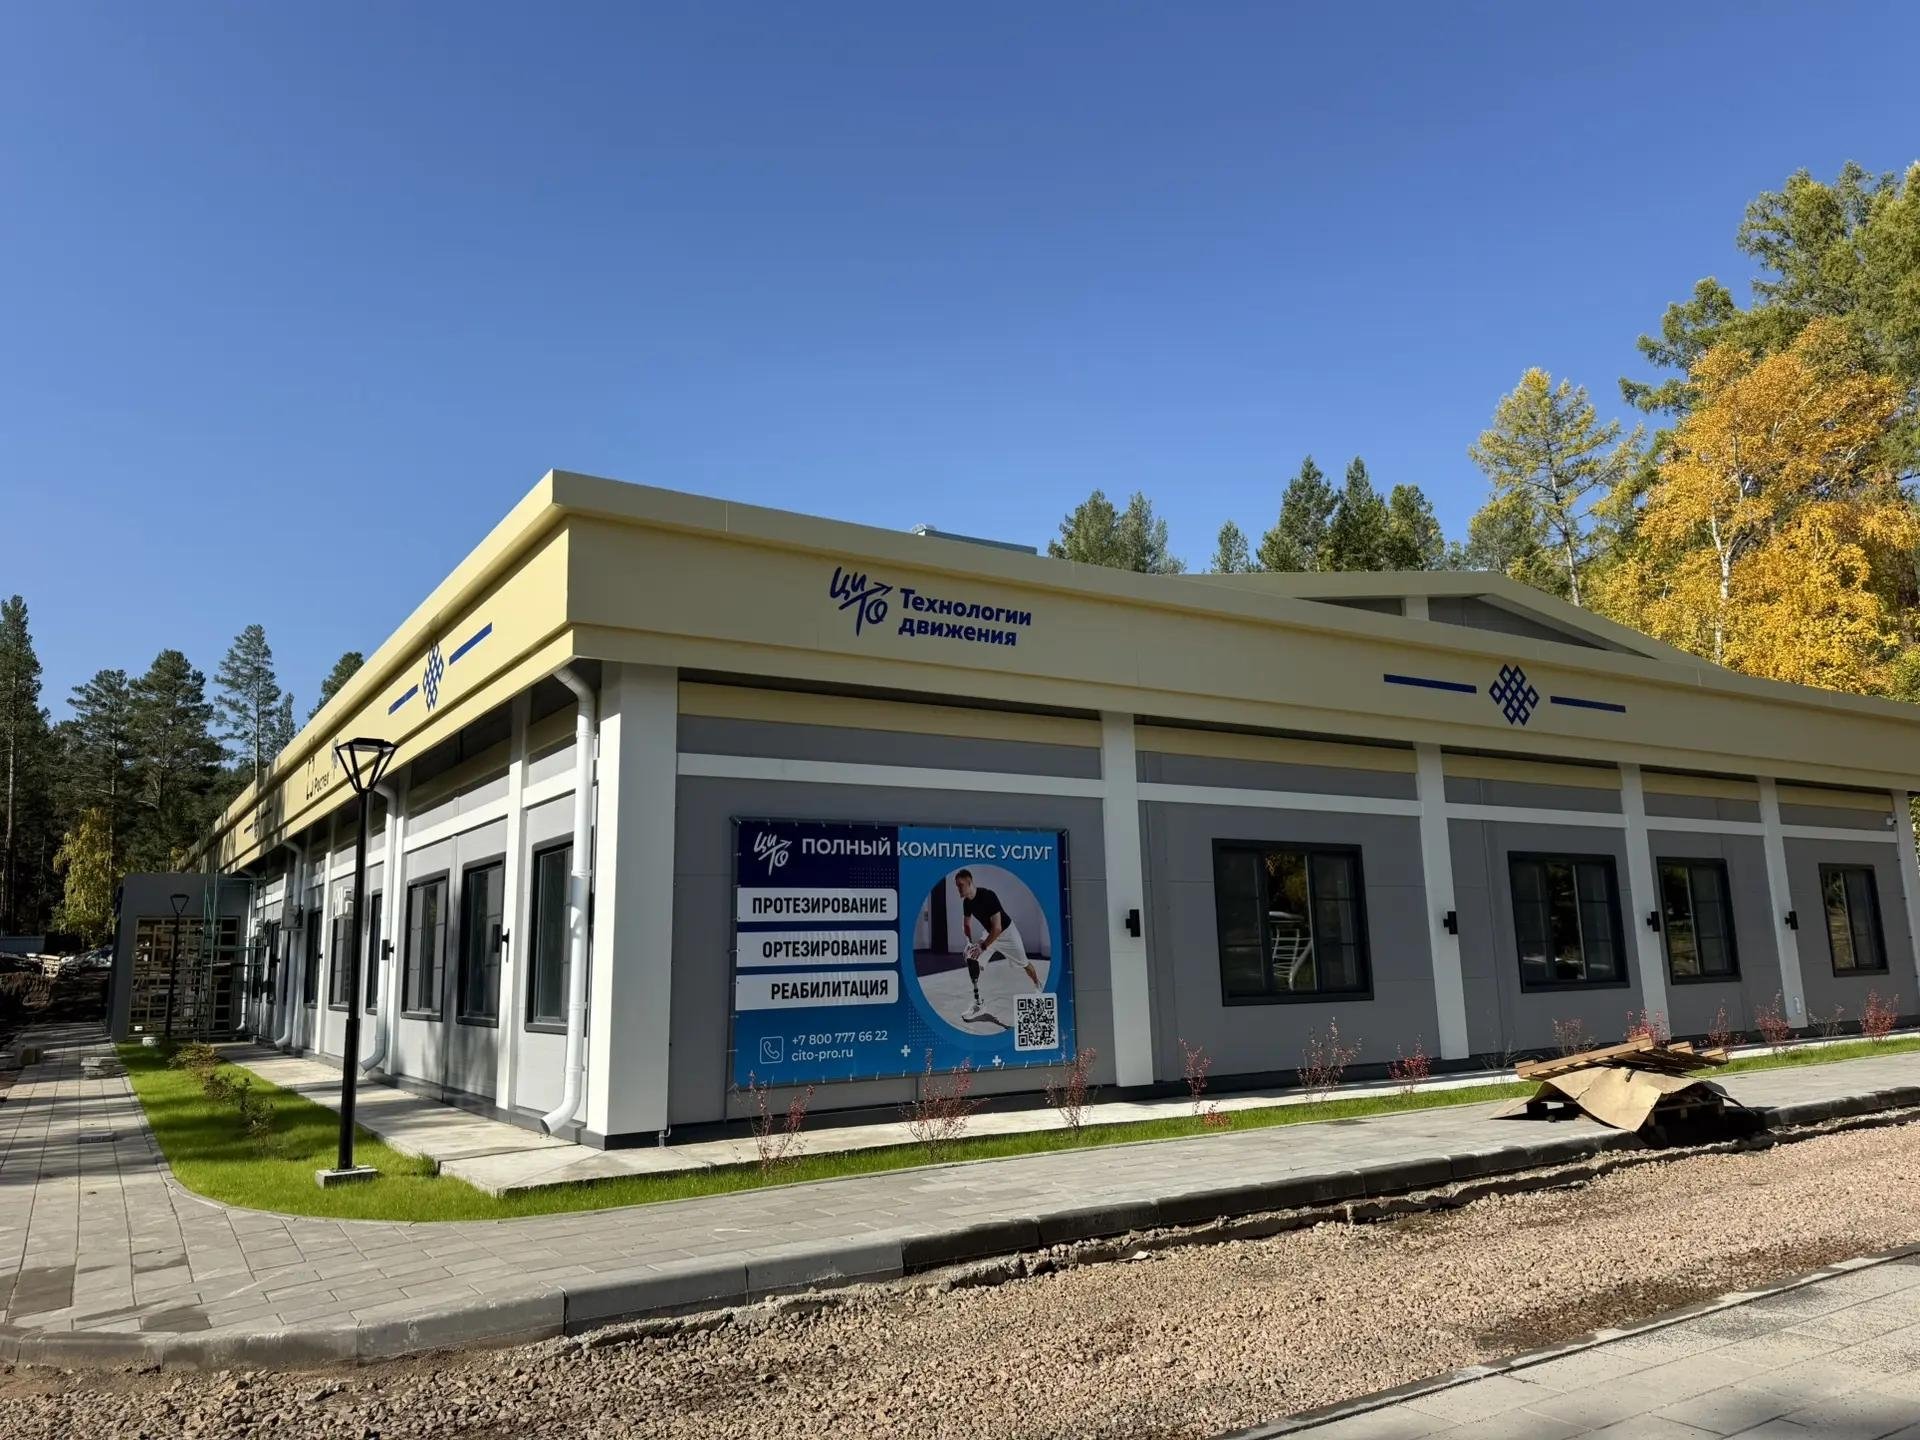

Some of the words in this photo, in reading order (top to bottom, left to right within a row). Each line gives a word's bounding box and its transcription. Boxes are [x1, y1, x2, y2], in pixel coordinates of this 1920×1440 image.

[900, 588, 1032, 626] Технологии
[898, 617, 1017, 646] движения
[802, 837, 891, 856] ПОЛНЫЙ
[897, 841, 996, 859] КОМПЛЕКС
[1000, 844, 1053, 861] УСЛУГ
[752, 897, 887, 914] ПРОТЕЗИРОВАНИЕ
[762, 939, 887, 958] ОРТЕЗИРОВАНИЕ
[771, 979, 888, 1000] РЕАБИЛИТАЦИЯ
[792, 1034, 806, 1046] +7
[809, 1033, 832, 1045] 800
[834, 1031, 856, 1043] 777
[858, 1030, 873, 1042] 66
[874, 1030, 888, 1041] 22
[791, 1048, 854, 1062] cito-pro.ru
